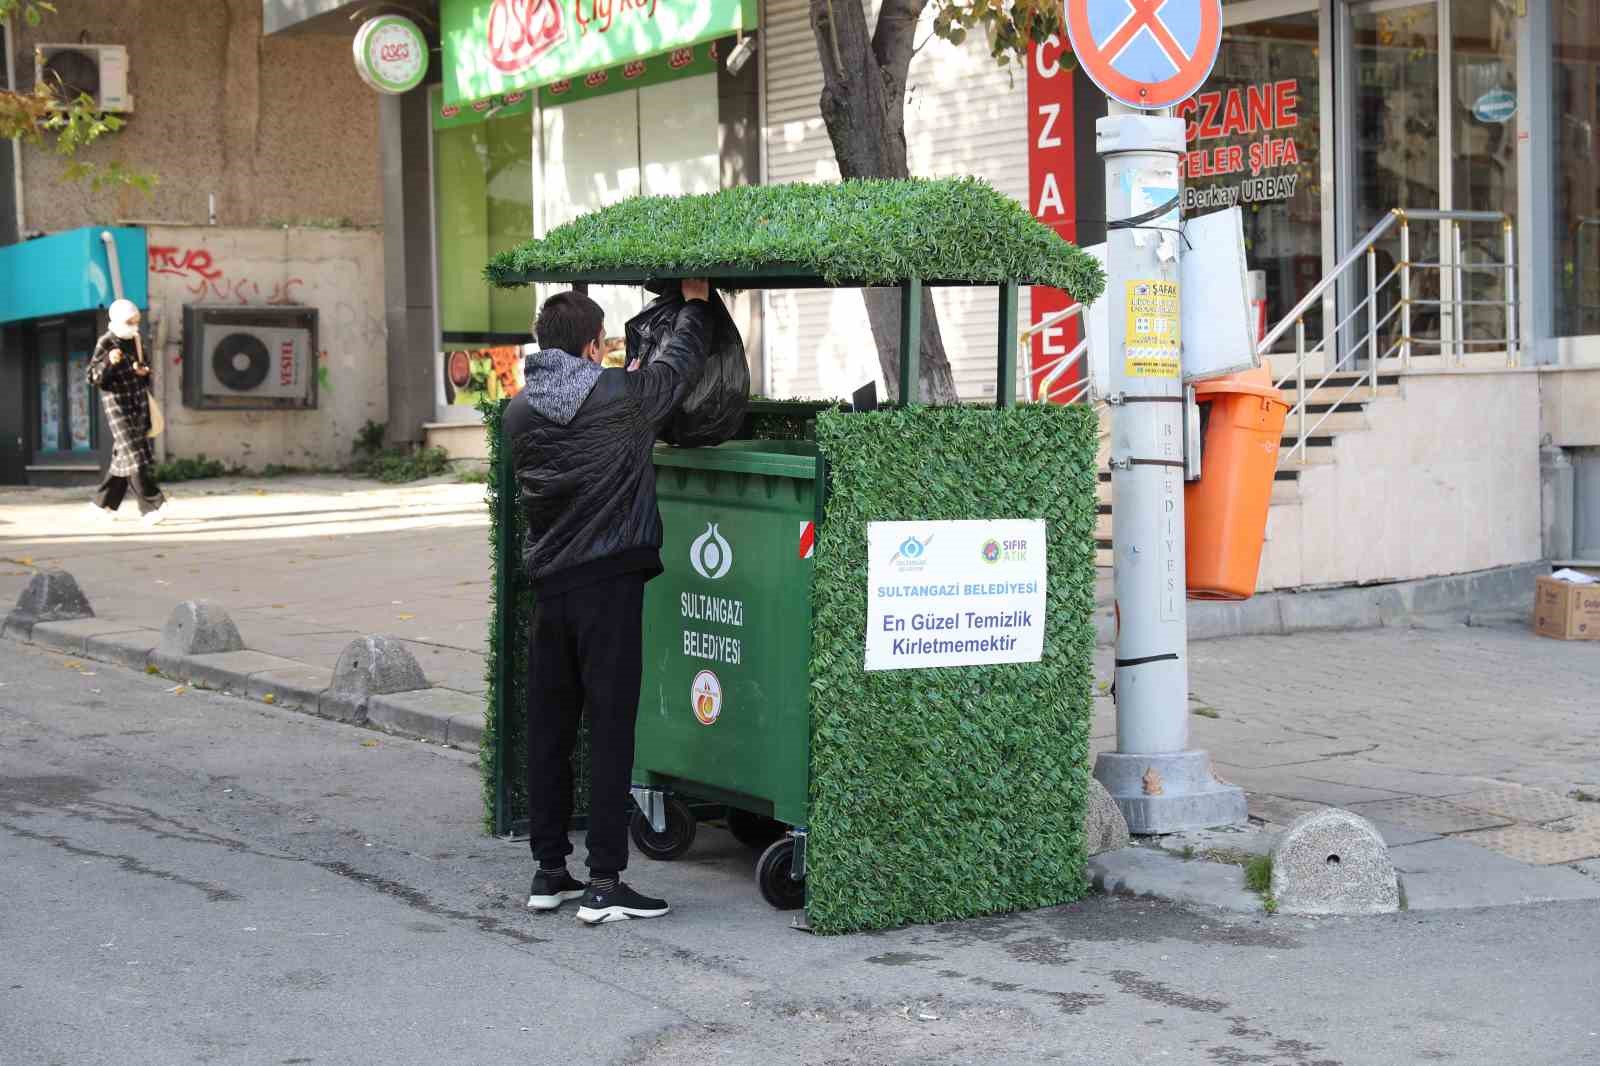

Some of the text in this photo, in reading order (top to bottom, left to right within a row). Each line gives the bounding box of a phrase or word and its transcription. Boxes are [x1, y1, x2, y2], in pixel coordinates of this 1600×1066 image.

[1249, 135, 1297, 176] ŞİFA
[1241, 174, 1297, 202] URBAY
[1002, 539, 1027, 550] SIFIR
[877, 580, 1038, 598] SULTANGAZİ BELEDİYESİ
[883, 610, 1032, 632] En Güzel Temizlik
[892, 634, 1017, 656] Kirletmemektir
